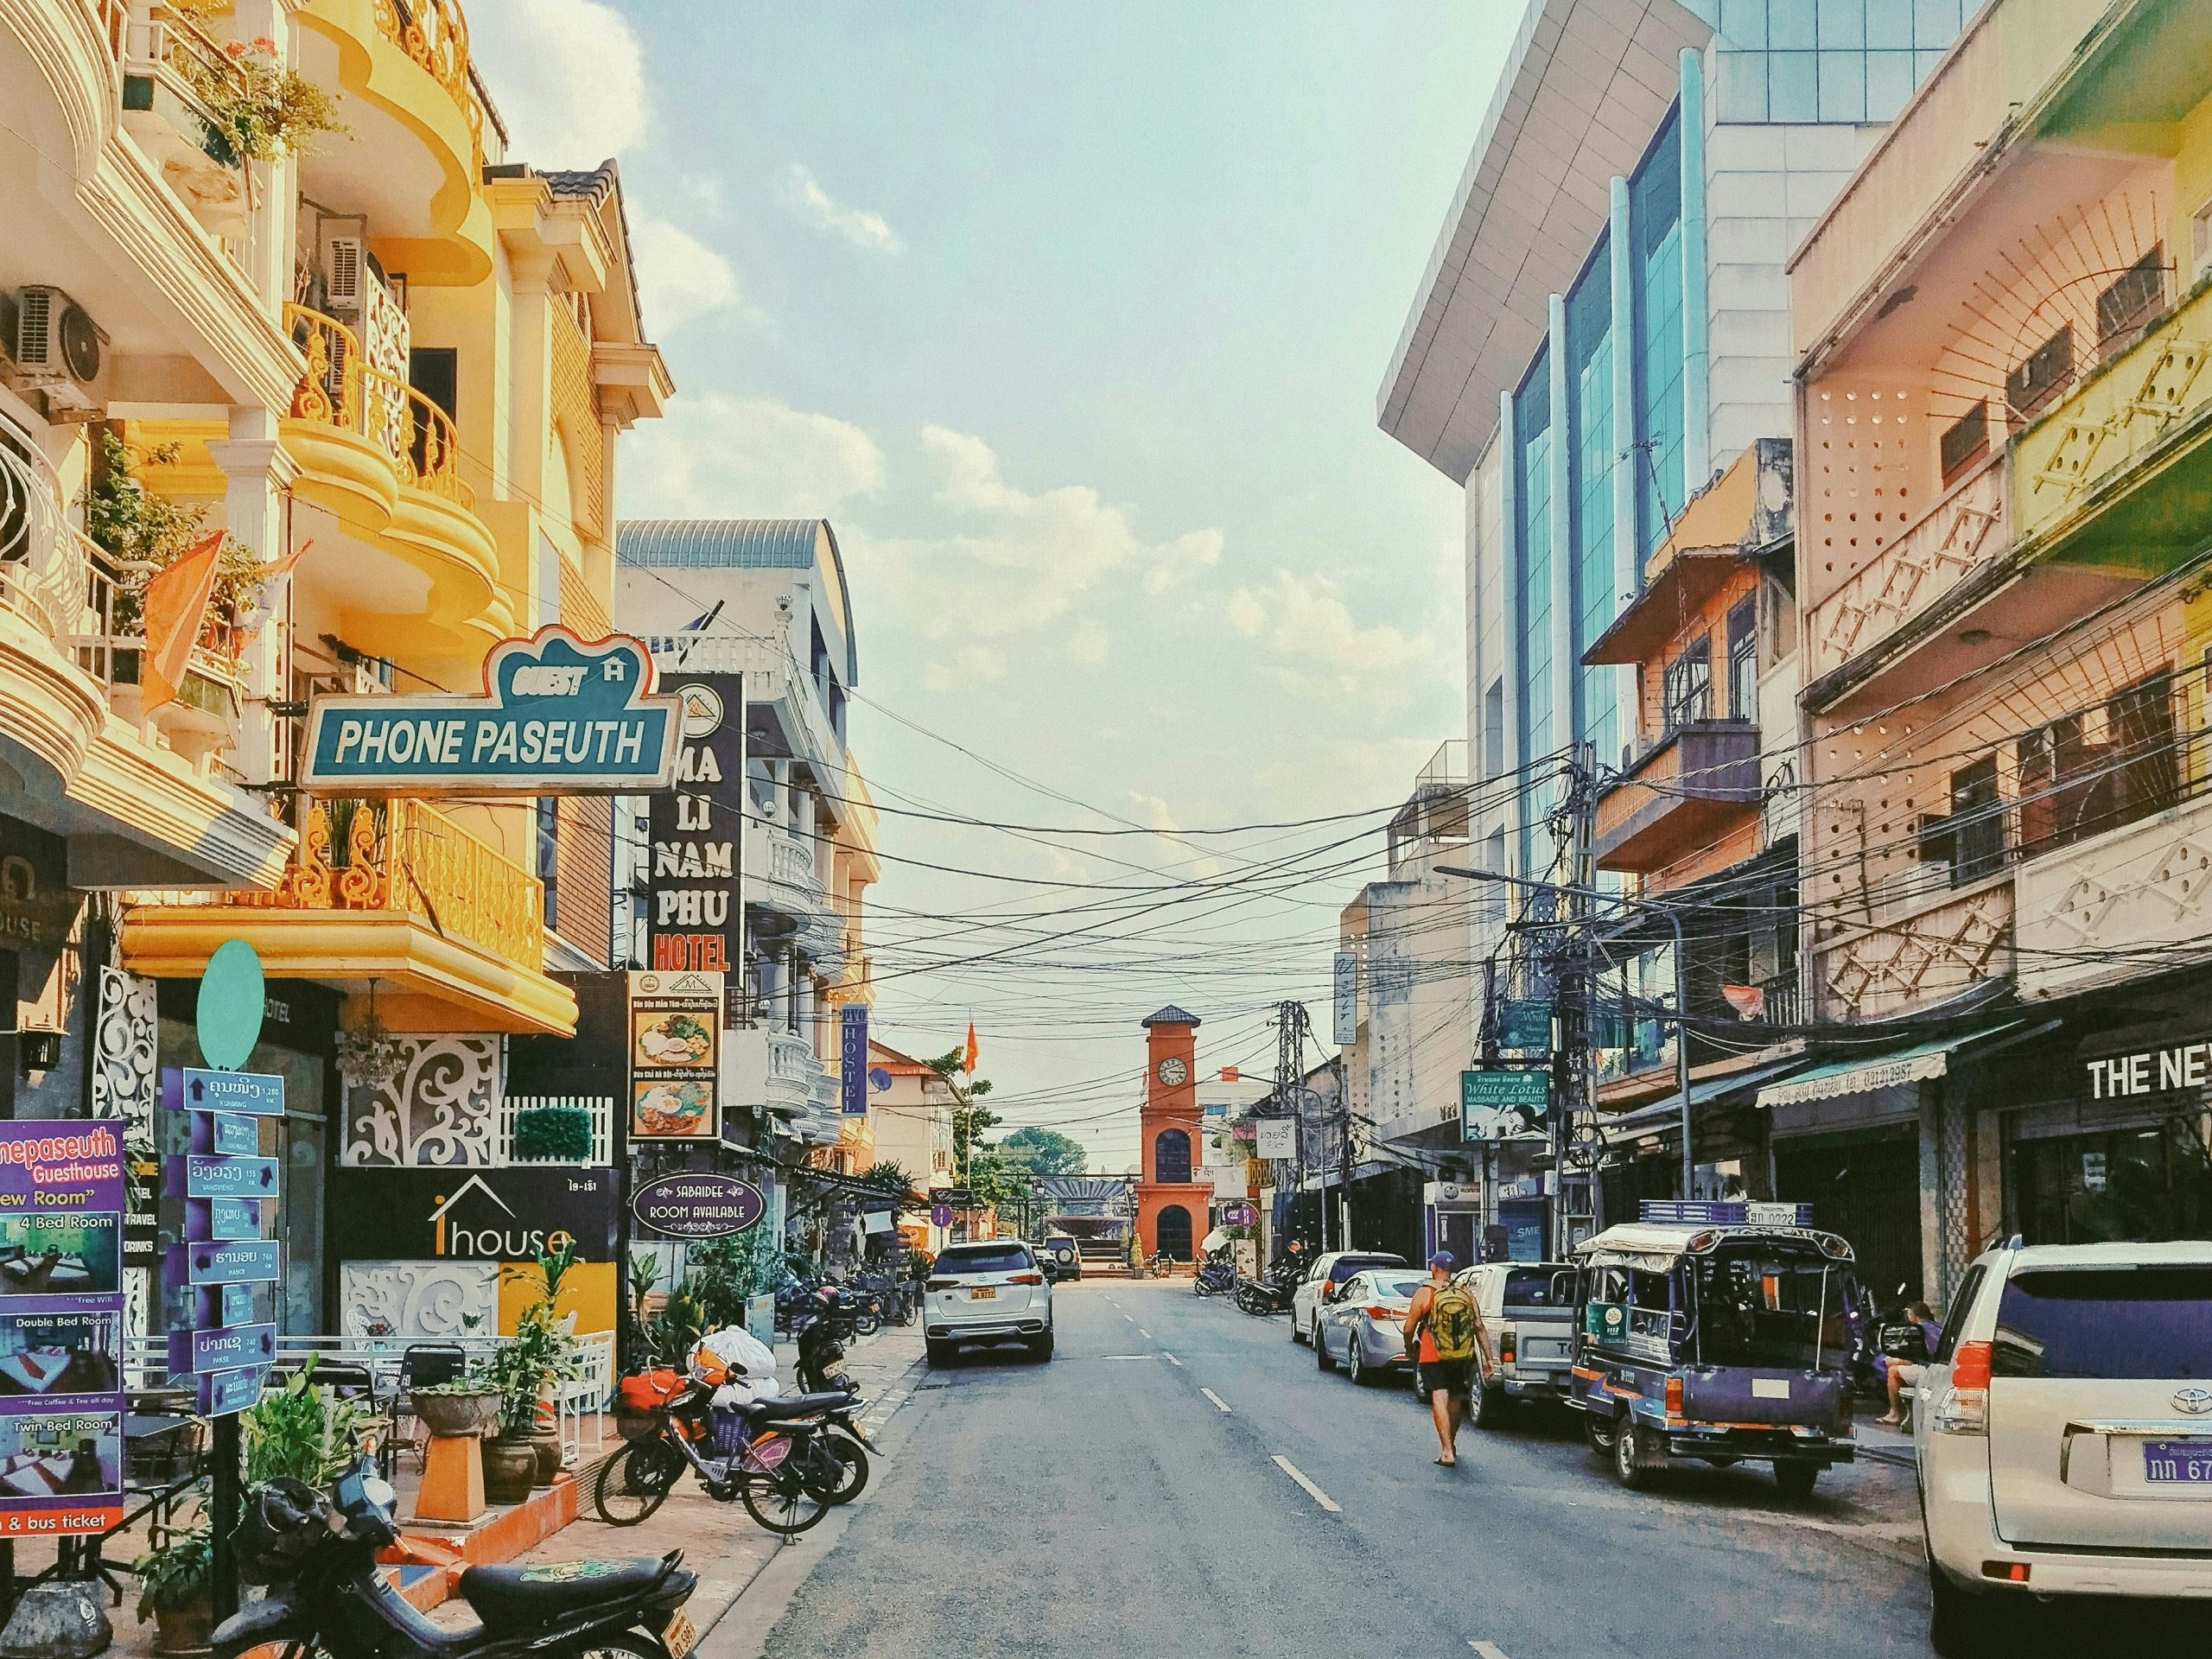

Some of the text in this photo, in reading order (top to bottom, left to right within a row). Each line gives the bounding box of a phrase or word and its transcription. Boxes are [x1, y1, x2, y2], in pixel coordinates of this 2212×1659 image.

[334, 720, 645, 764] PHONE PASEUTH
[677, 794, 711, 830] LI
[654, 842, 733, 878] NAM
[657, 890, 729, 926] PHU
[654, 933, 730, 971] HOTEL
[265, 997, 290, 1023] OTEL
[844, 1027, 856, 1112] HOSTEL
[2088, 1043, 2212, 1099] THE NE
[1466, 1083, 1547, 1095] White Lotus
[219, 1099, 247, 1108] KUNMING
[33, 1162, 119, 1184] Guesthouse
[676, 1185, 723, 1198] SABAIDEE
[650, 1205, 745, 1218] ROOM AVAILABLE
[20, 1215, 112, 1229] 4 Bed Room
[1517, 1225, 1541, 1237] SME
[16, 1316, 111, 1327] Double Bed Room
[213, 1356, 230, 1364] PAKSE
[14, 1420, 112, 1432] Twin Bed Room
[9, 1514, 105, 1530] & bus ticket
